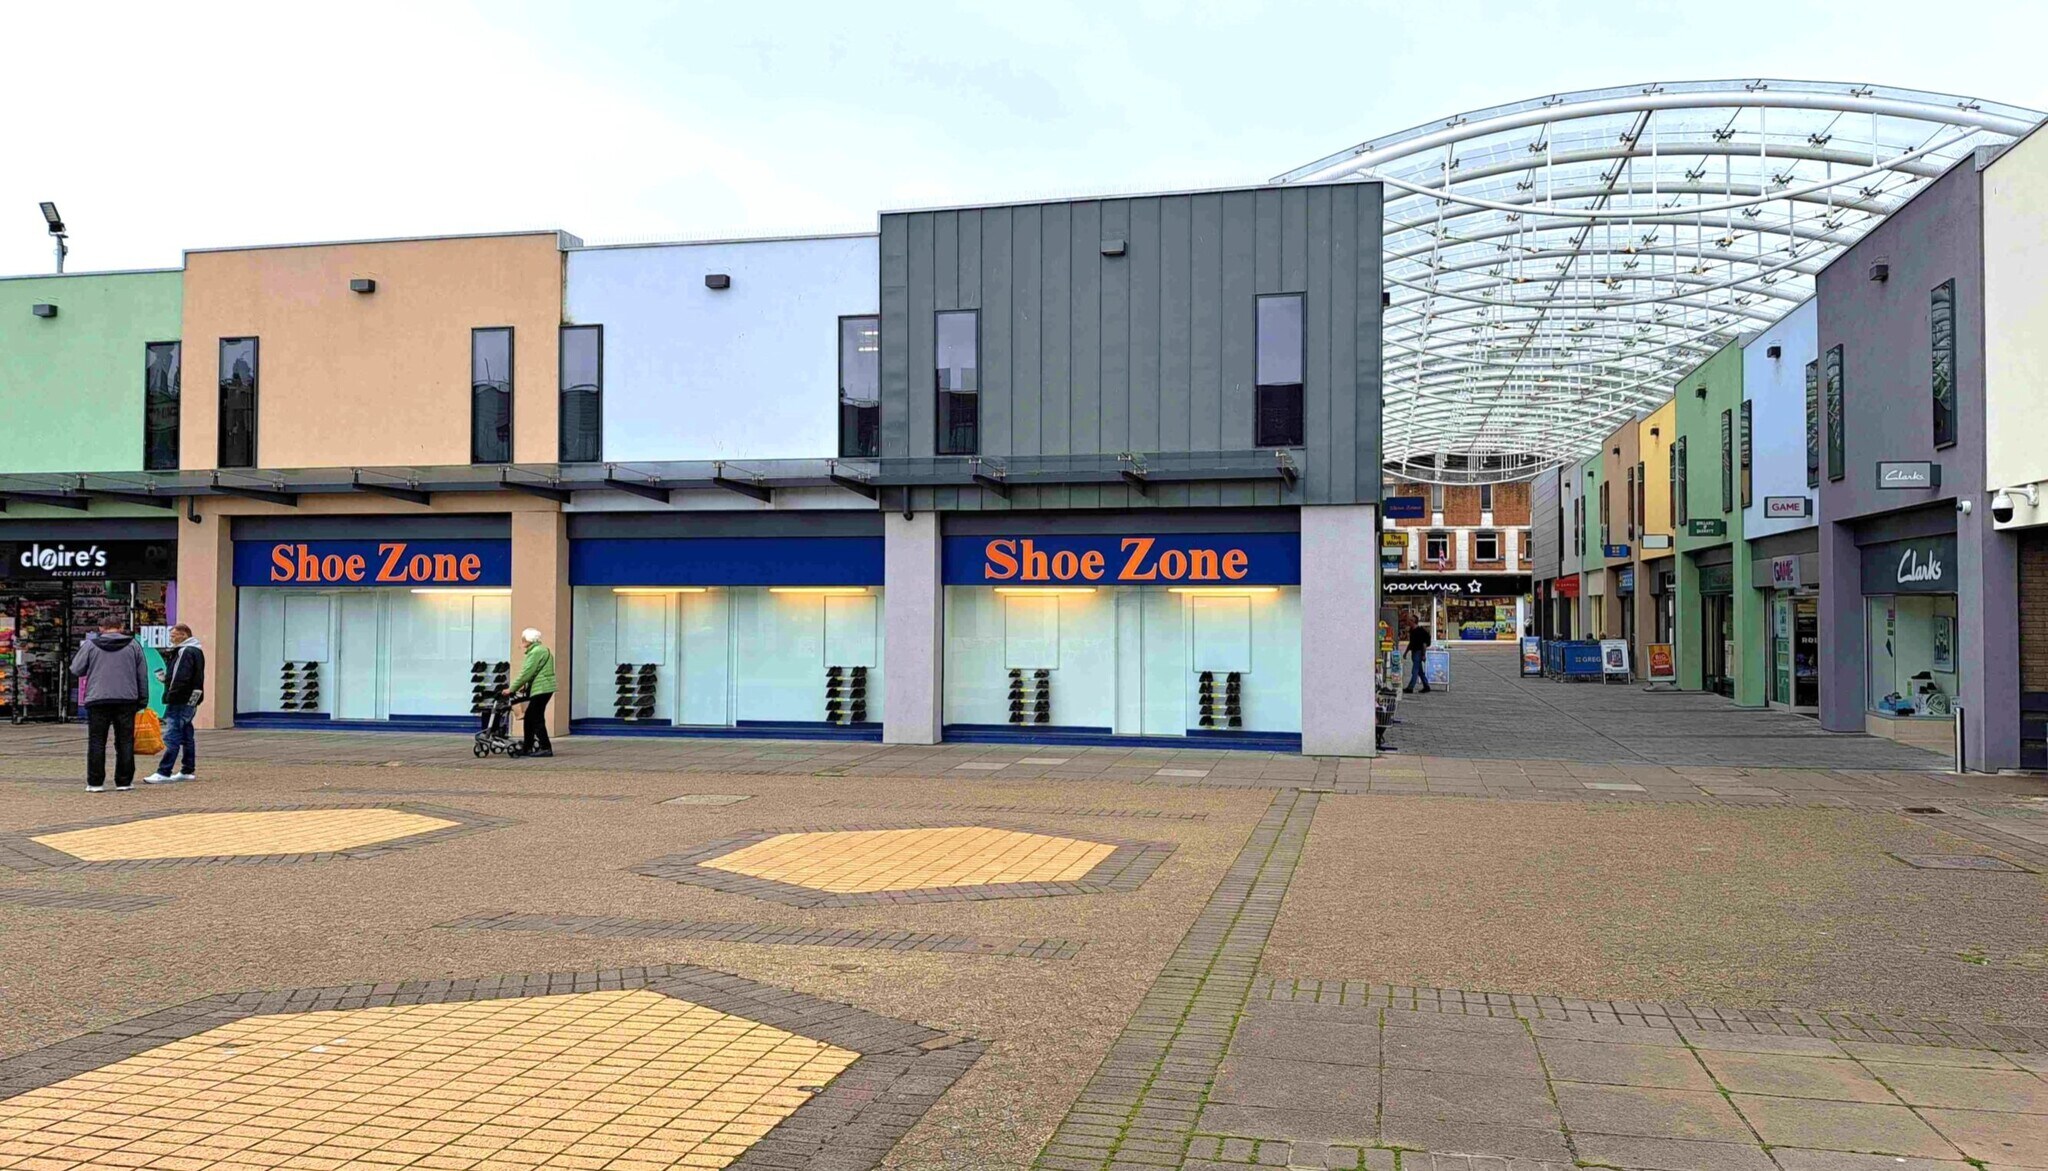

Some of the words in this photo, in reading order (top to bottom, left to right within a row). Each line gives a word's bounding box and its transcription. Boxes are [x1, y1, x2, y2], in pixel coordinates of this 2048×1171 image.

[1885, 470, 1925, 481] Clarks
[1771, 502, 1800, 512] GAME
[20, 543, 107, 570] claire's
[271, 543, 366, 582] Shoe
[375, 543, 481, 582] Zone
[985, 539, 1105, 581] Shoe
[1117, 537, 1249, 580] Zone
[1897, 548, 1942, 583] Clarks
[1773, 560, 1794, 582] GAME
